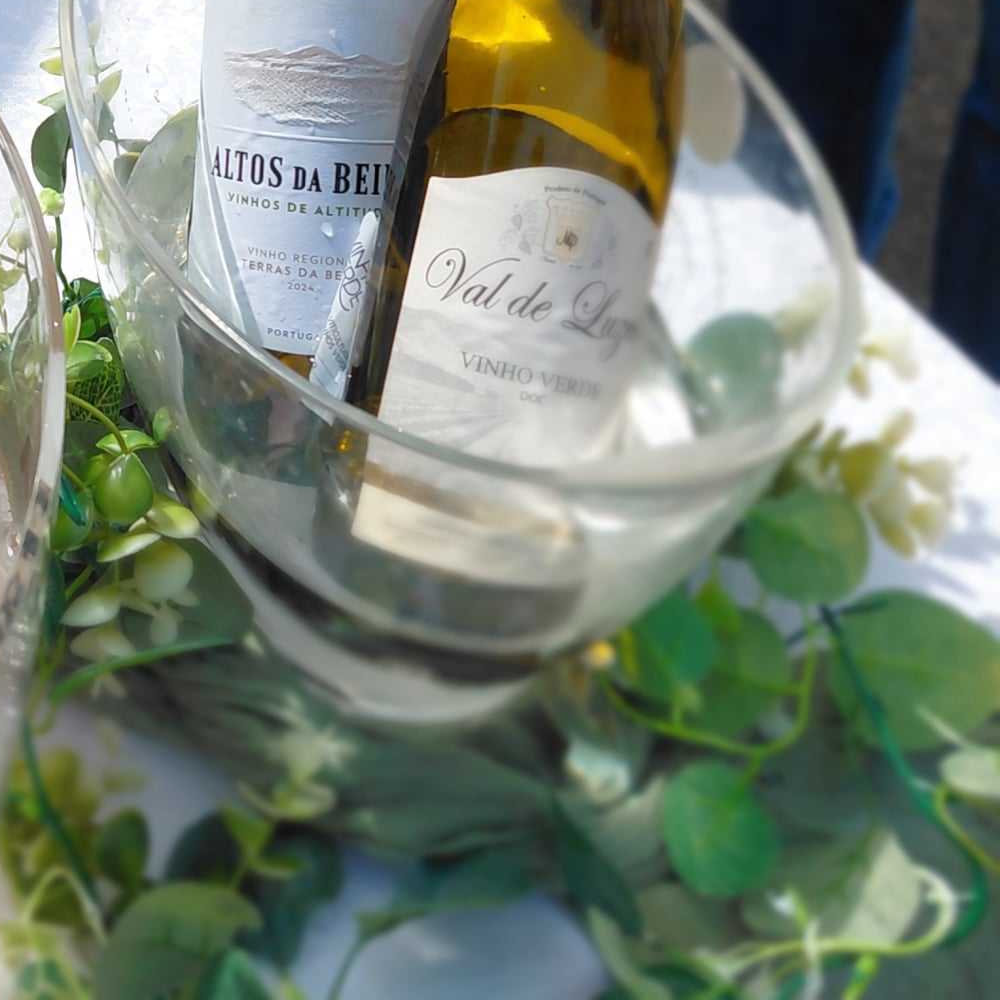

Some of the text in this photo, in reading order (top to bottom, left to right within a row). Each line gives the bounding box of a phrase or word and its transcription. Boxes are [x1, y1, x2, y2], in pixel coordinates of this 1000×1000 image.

[210, 145, 284, 189] ALTOS
[293, 166, 323, 193] DA
[227, 191, 281, 212] VINHOS
[287, 201, 309, 215] DE
[247, 246, 347, 267] VINHO REGION
[241, 258, 292, 276] TERRAS
[298, 267, 319, 280] DA
[287, 281, 315, 293] 2024
[425, 247, 521, 311] Val
[507, 281, 553, 322] de
[461, 350, 534, 385] VINHO
